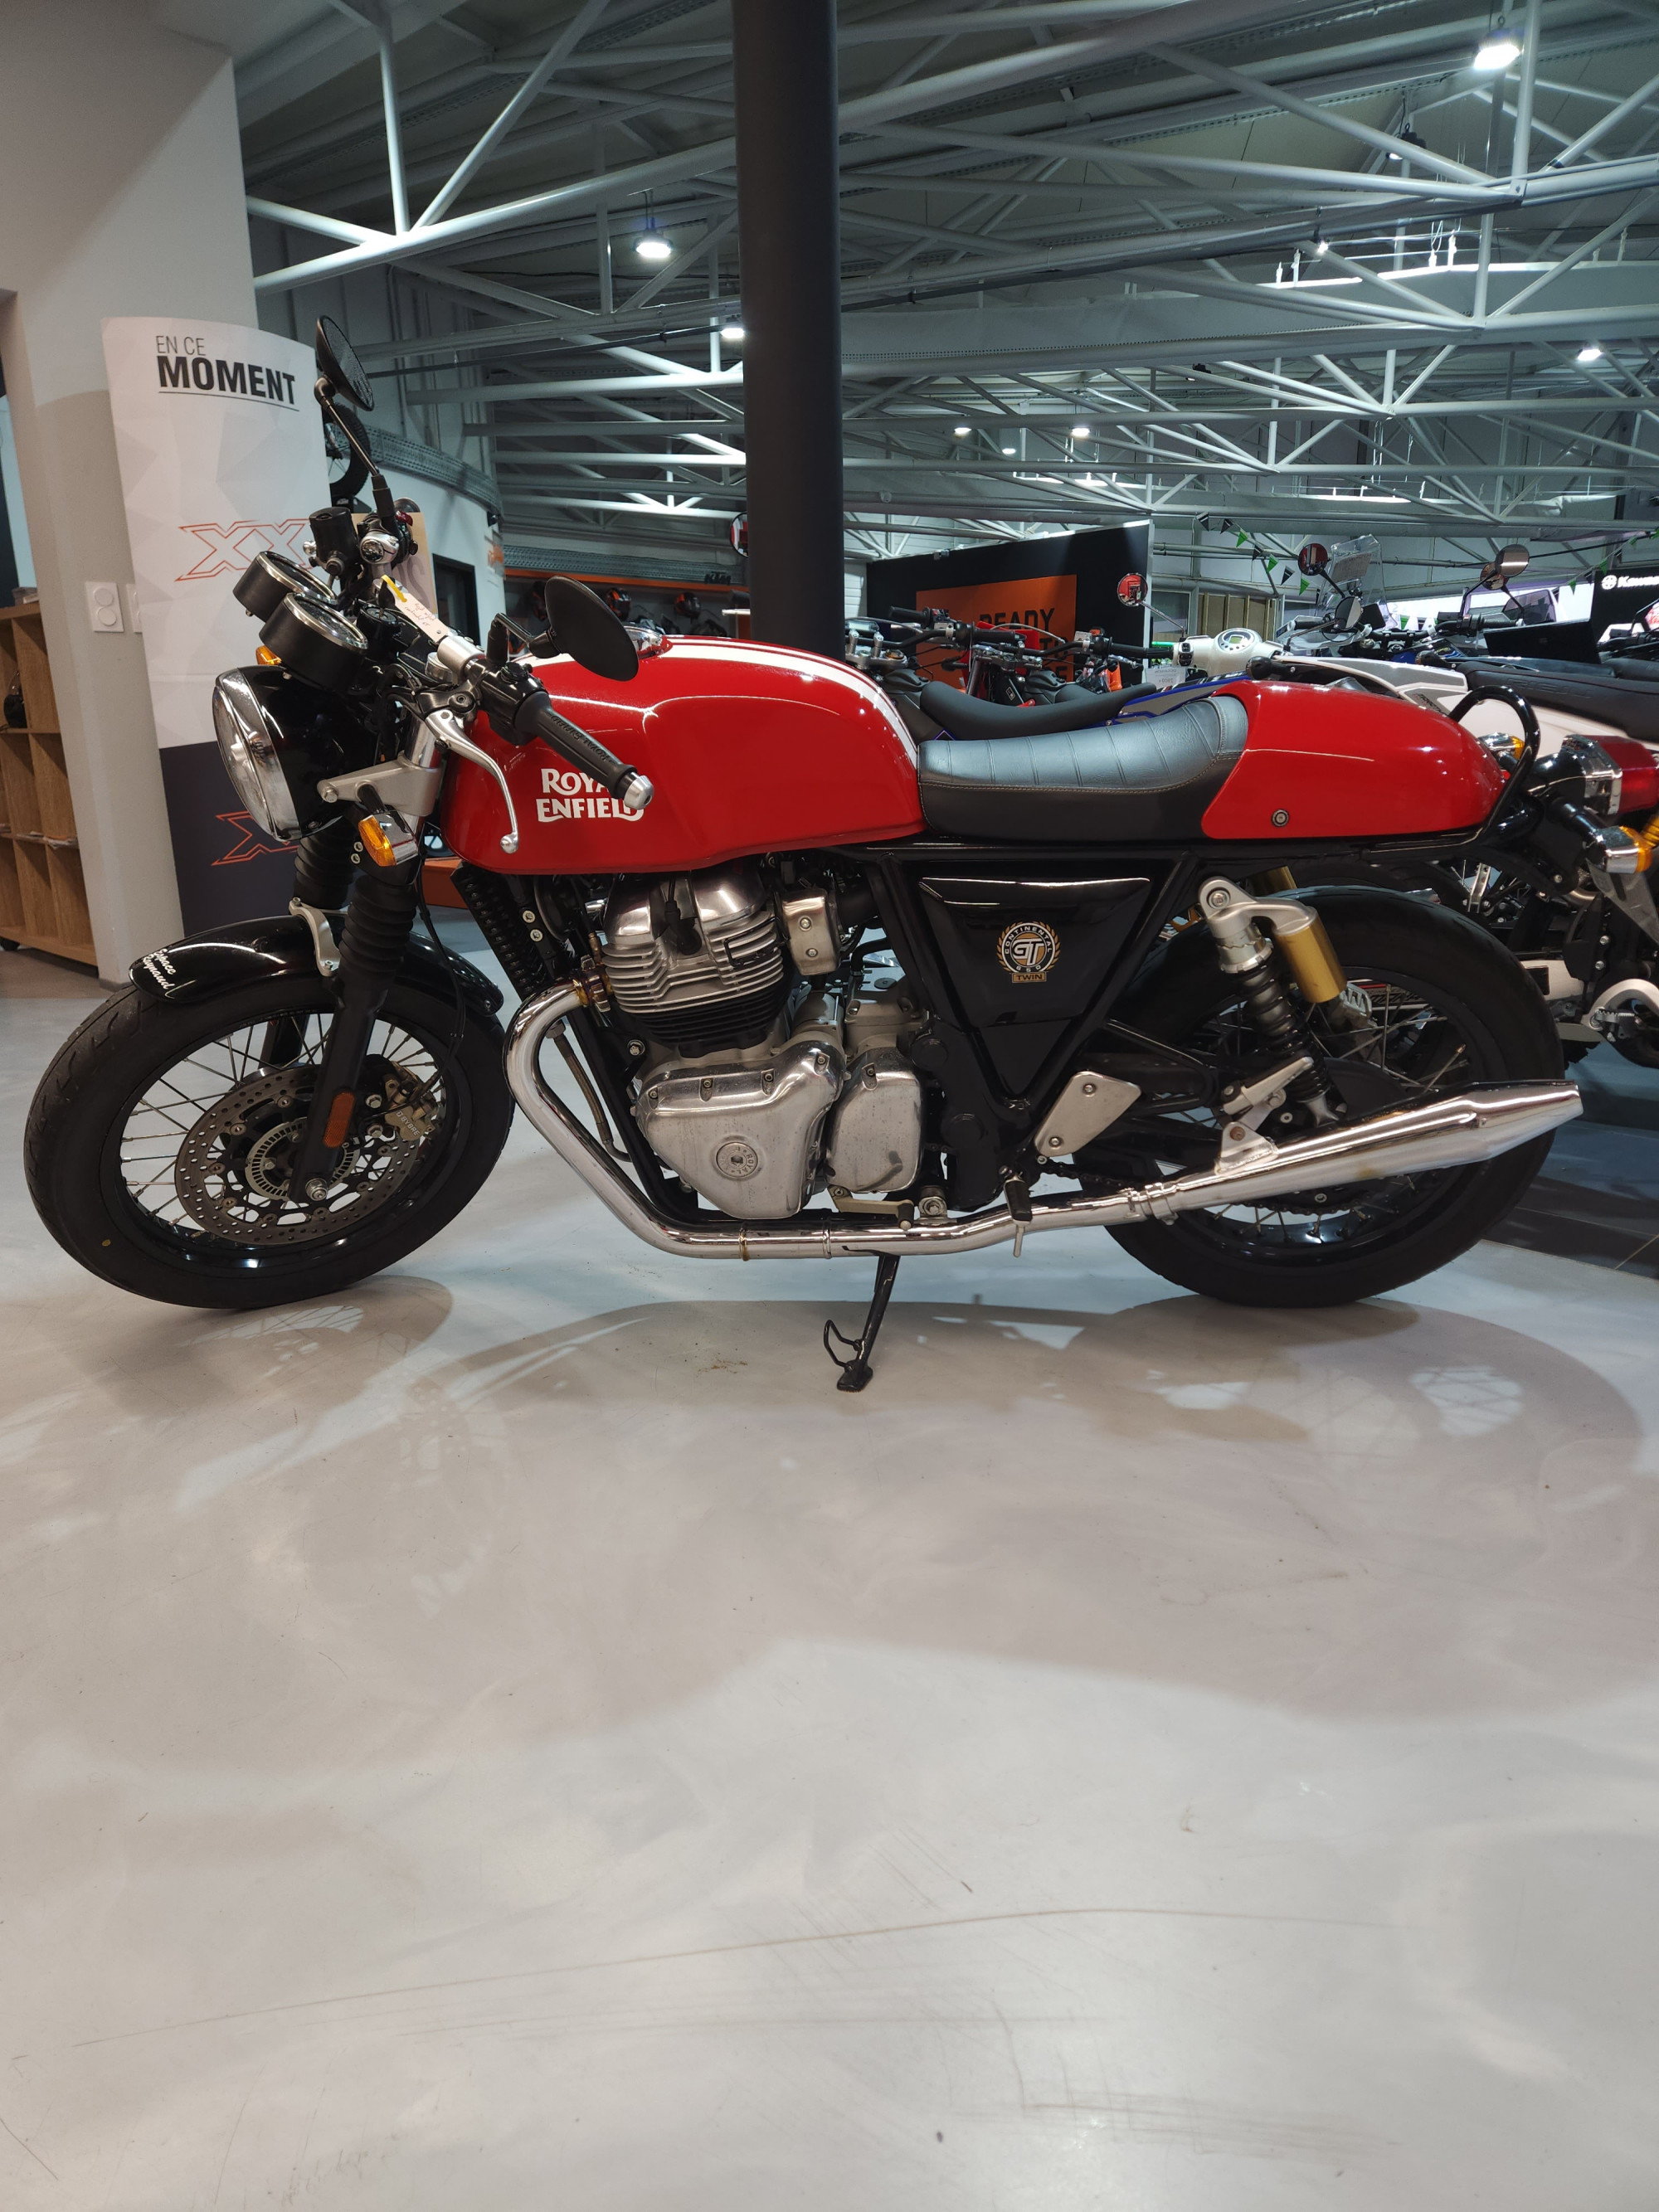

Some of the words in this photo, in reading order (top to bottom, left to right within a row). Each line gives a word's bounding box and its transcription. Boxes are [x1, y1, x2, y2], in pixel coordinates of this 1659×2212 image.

[156, 335, 178, 354] EN
[183, 337, 206, 356] CE
[157, 355, 295, 405] MOMENT
[540, 768, 610, 795] ROYA
[1005, 926, 1053, 955] CONTINENTAL
[1011, 938, 1045, 965] GT
[153, 948, 177, 975] Espace
[401, 1116, 421, 1136] BYBRE
